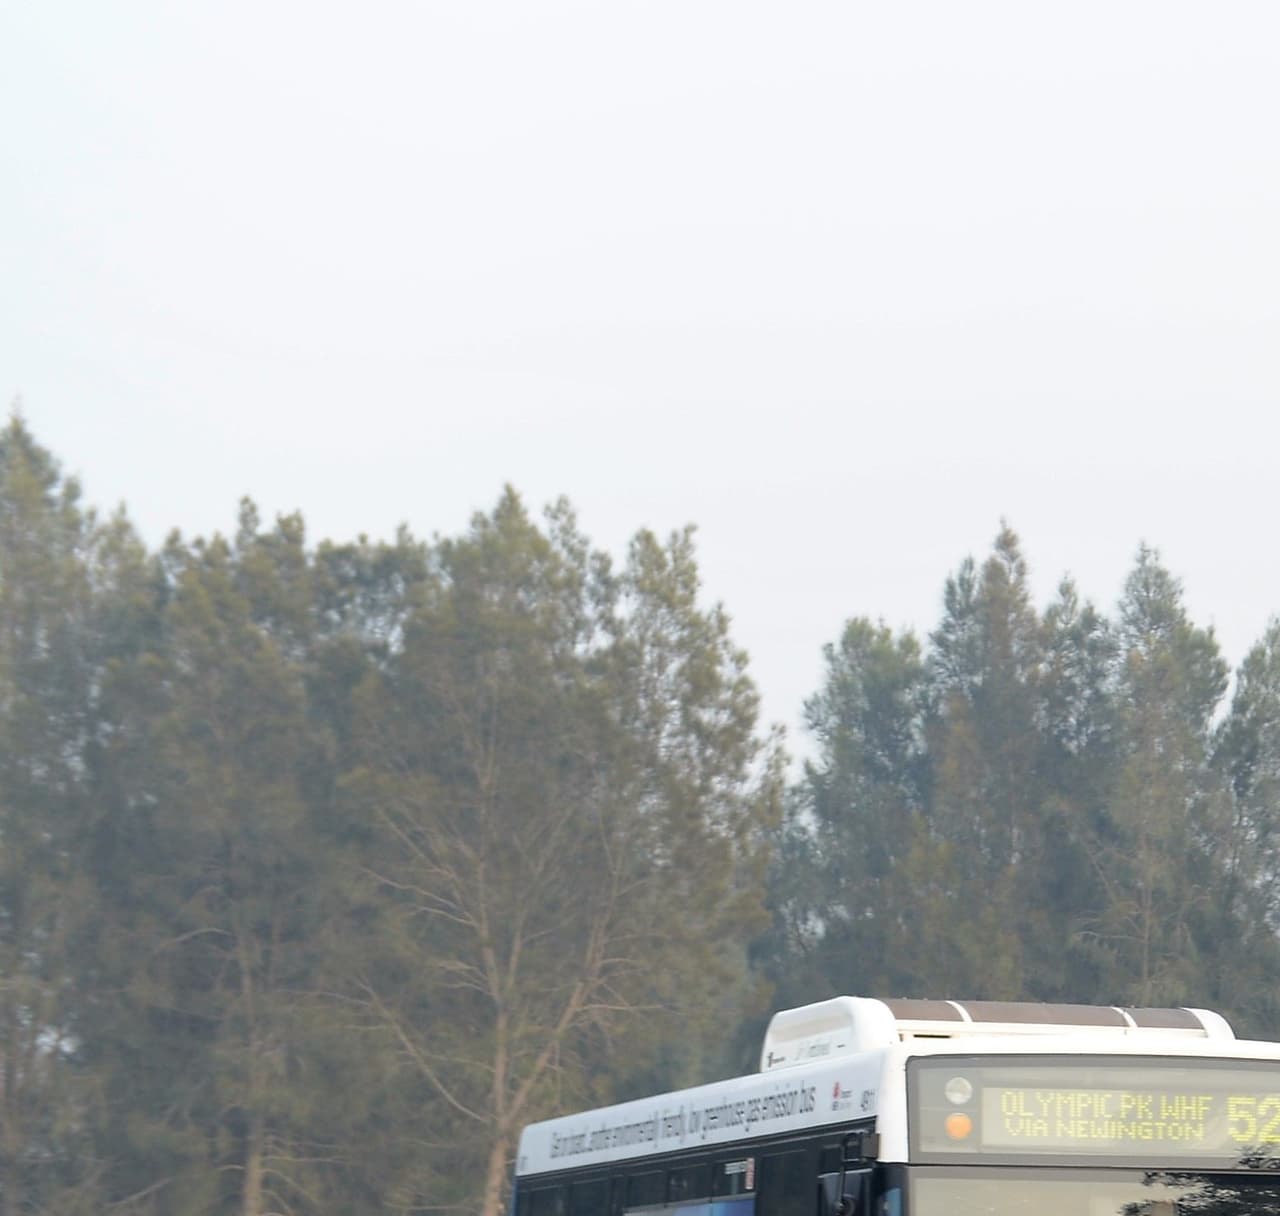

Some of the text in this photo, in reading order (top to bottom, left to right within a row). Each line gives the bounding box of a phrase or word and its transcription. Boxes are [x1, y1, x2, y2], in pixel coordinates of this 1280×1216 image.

[702, 1096, 746, 1140] greenhouse
[746, 1098, 760, 1132] gas
[762, 1084, 798, 1118] emission
[800, 1080, 816, 1113] bus
[1000, 1091, 1213, 1121] OLYMPIC PK WHF
[1004, 1116, 1204, 1141] VIA NEWINGTON
